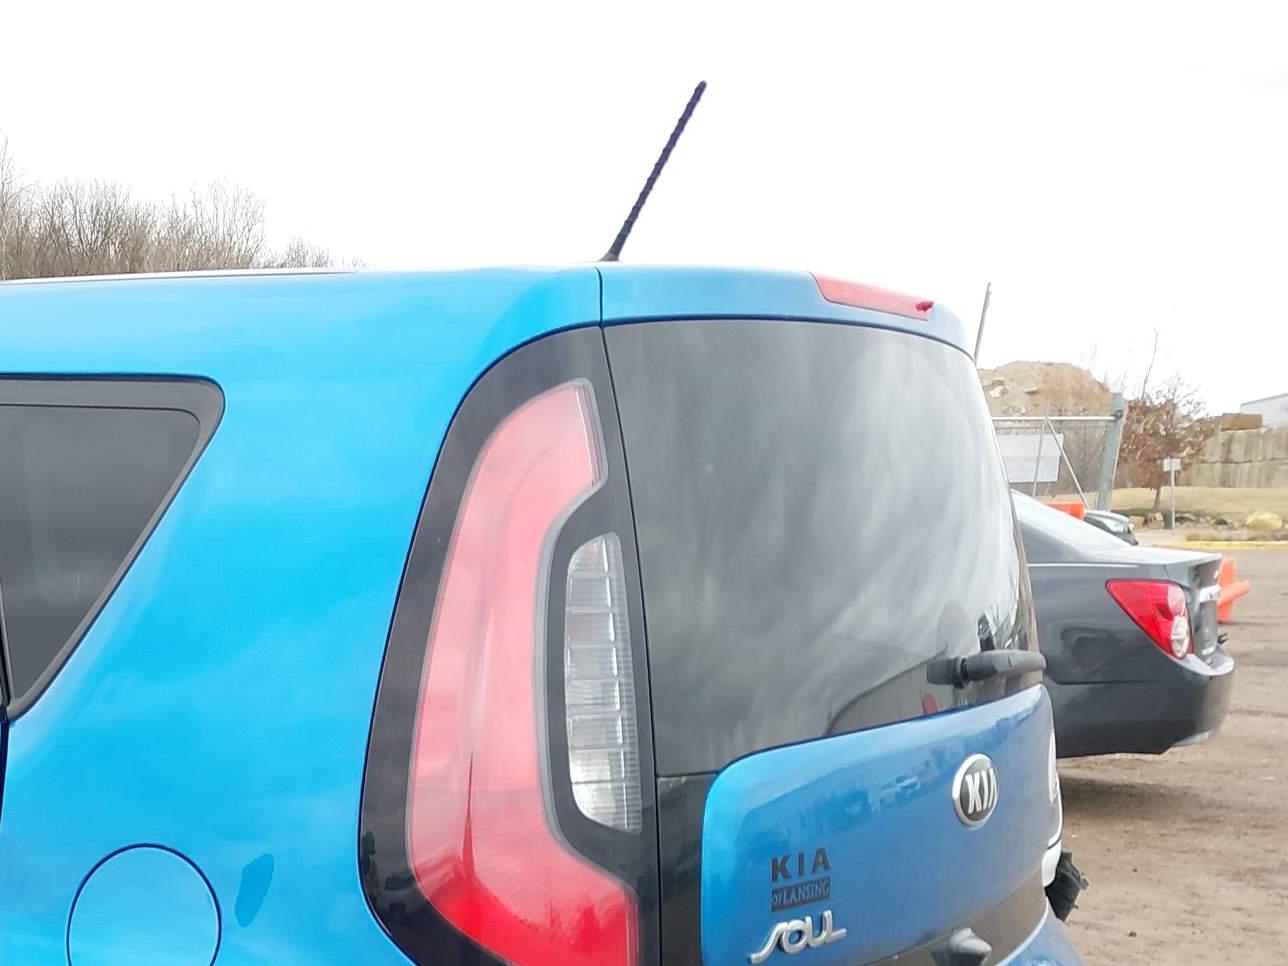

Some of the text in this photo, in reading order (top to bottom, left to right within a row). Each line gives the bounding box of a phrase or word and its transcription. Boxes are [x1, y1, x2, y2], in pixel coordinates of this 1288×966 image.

[771, 848, 830, 882] KIA
[783, 879, 830, 905] LANSING
[748, 909, 848, 965] SOUL
